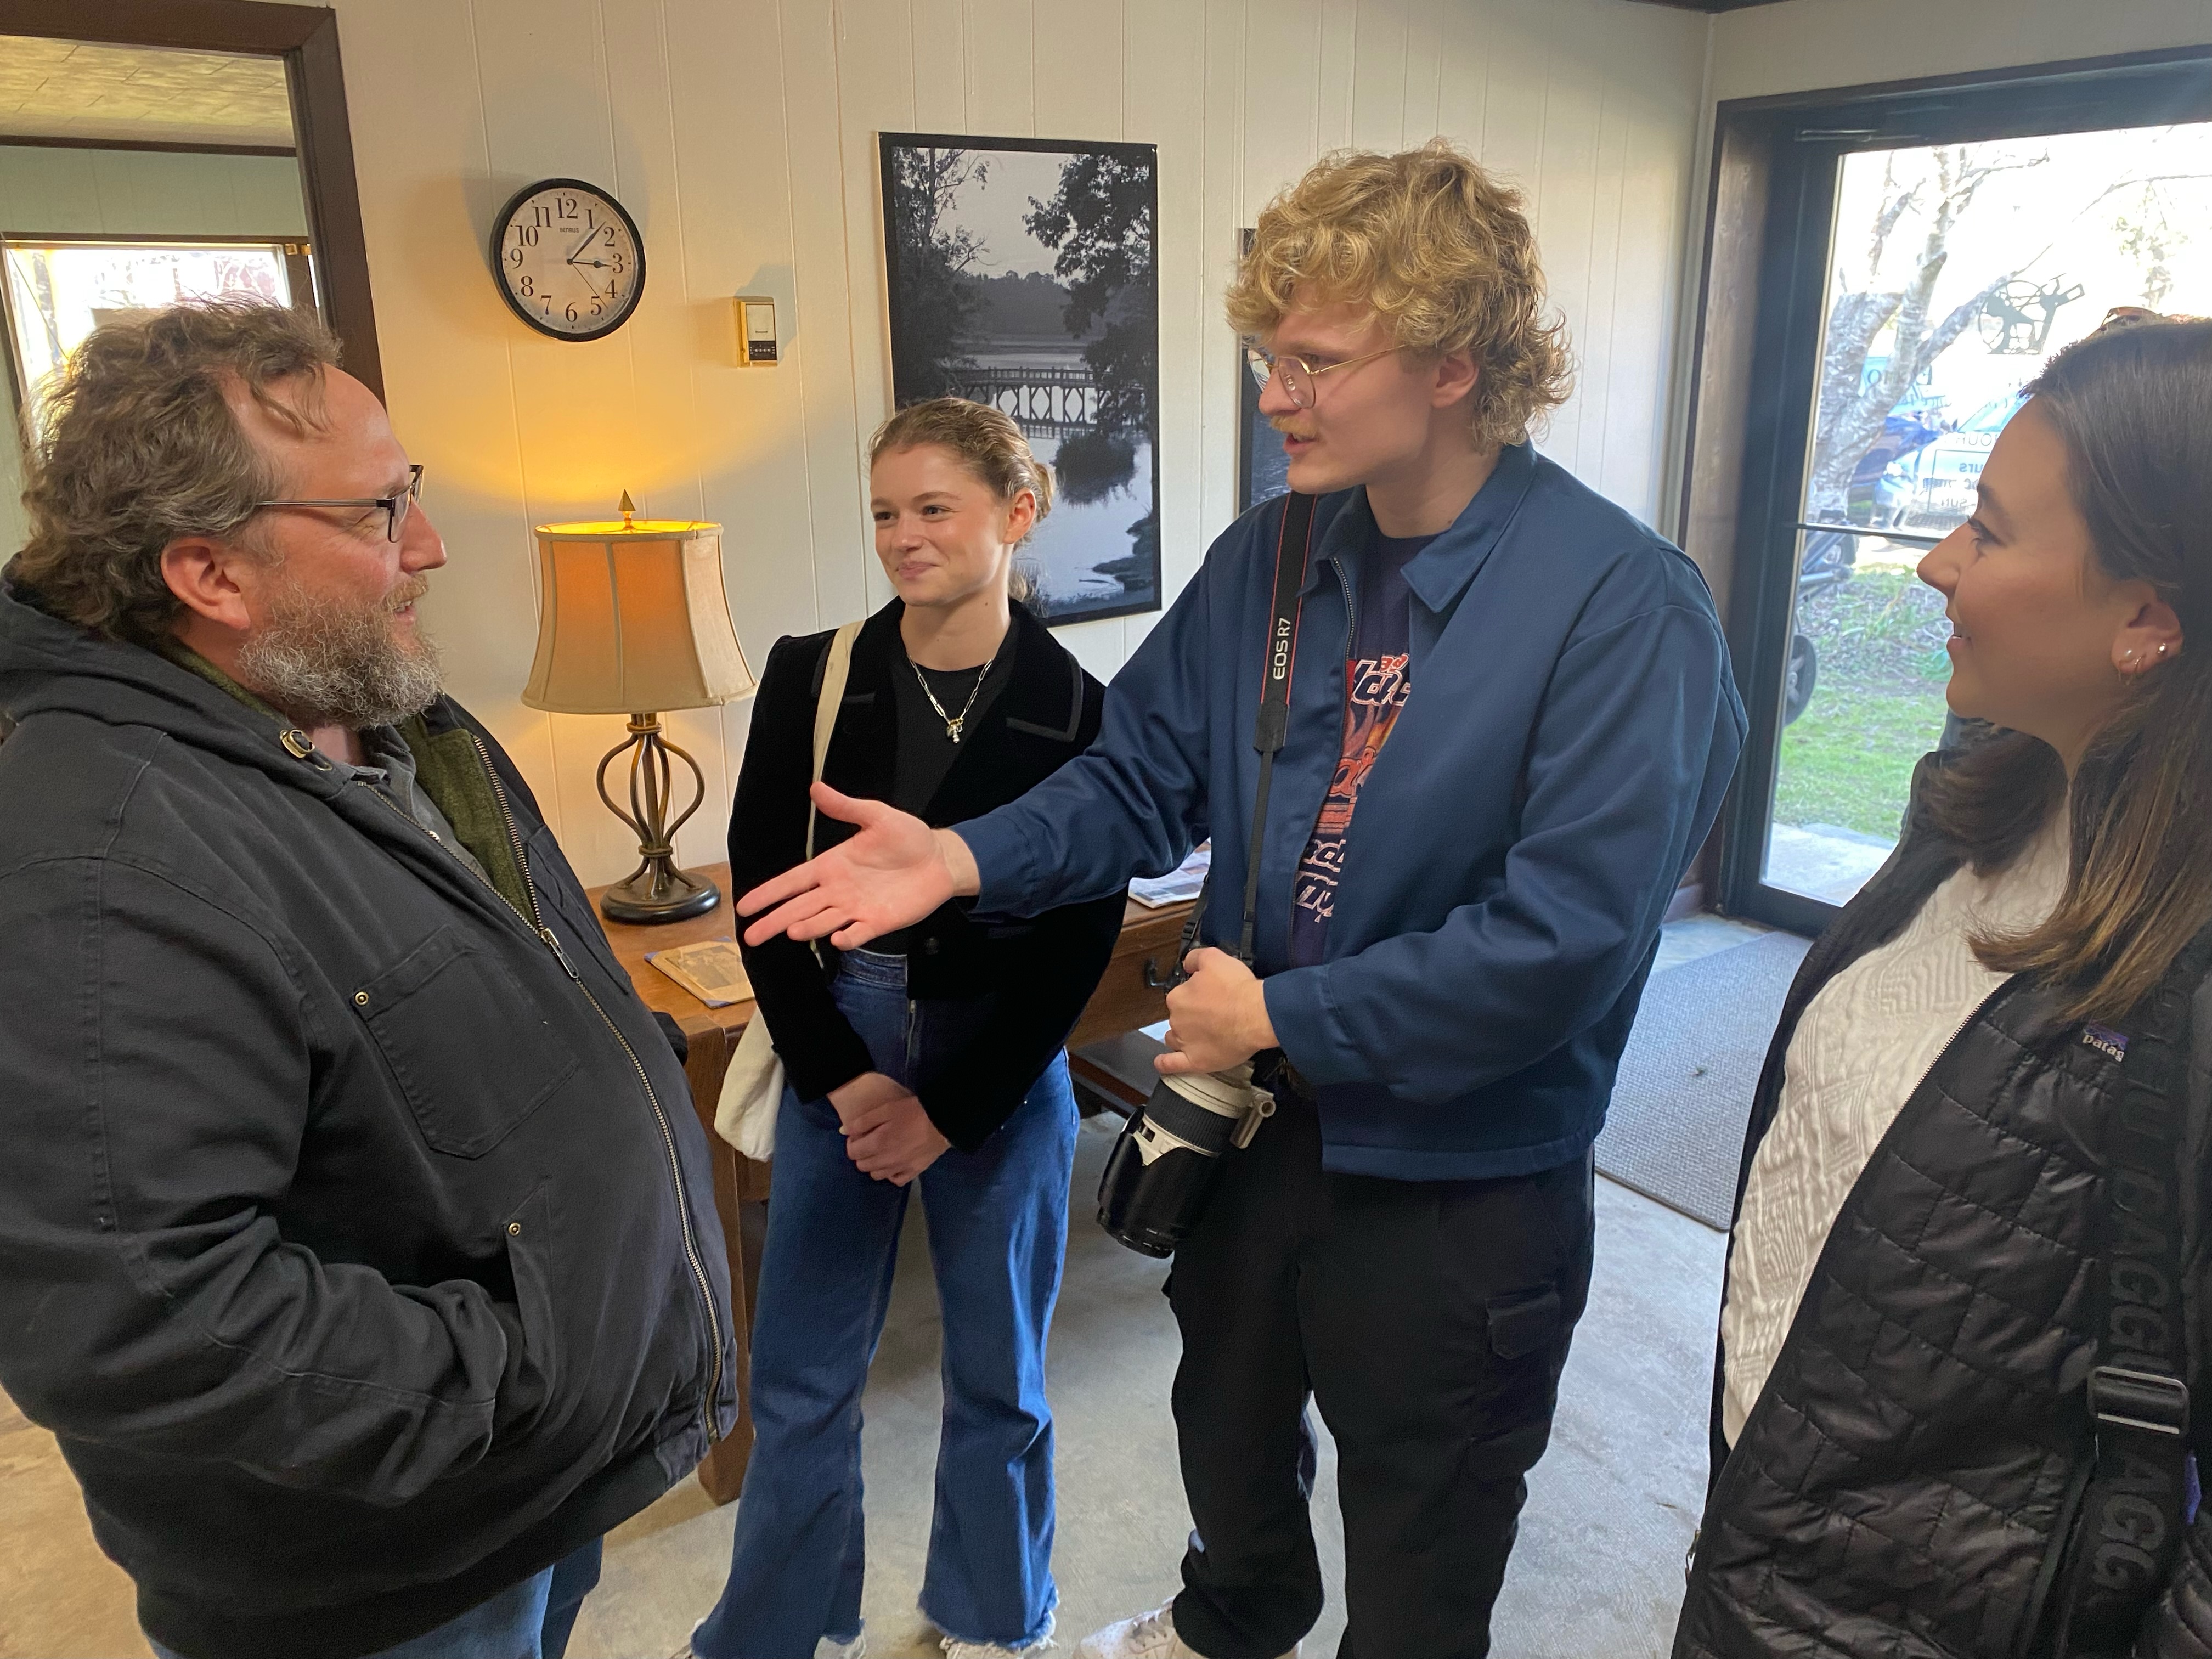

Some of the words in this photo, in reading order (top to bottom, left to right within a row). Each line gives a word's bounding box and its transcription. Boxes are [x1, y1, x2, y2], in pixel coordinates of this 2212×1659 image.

[533, 206, 552, 228] 11
[555, 198, 578, 219] 12
[585, 208, 595, 229] 1
[515, 225, 538, 247] 10
[603, 227, 616, 247] 2
[510, 248, 523, 269] 9
[612, 253, 624, 274] 3
[521, 275, 534, 297] 8
[605, 279, 618, 298] 4
[540, 295, 552, 315] 7
[565, 302, 578, 322] 6
[590, 296, 602, 315] 5
[1277, 617, 1291, 637] R7
[1272, 639, 1289, 680] EOS
[2083, 1034, 2124, 1062] patag
